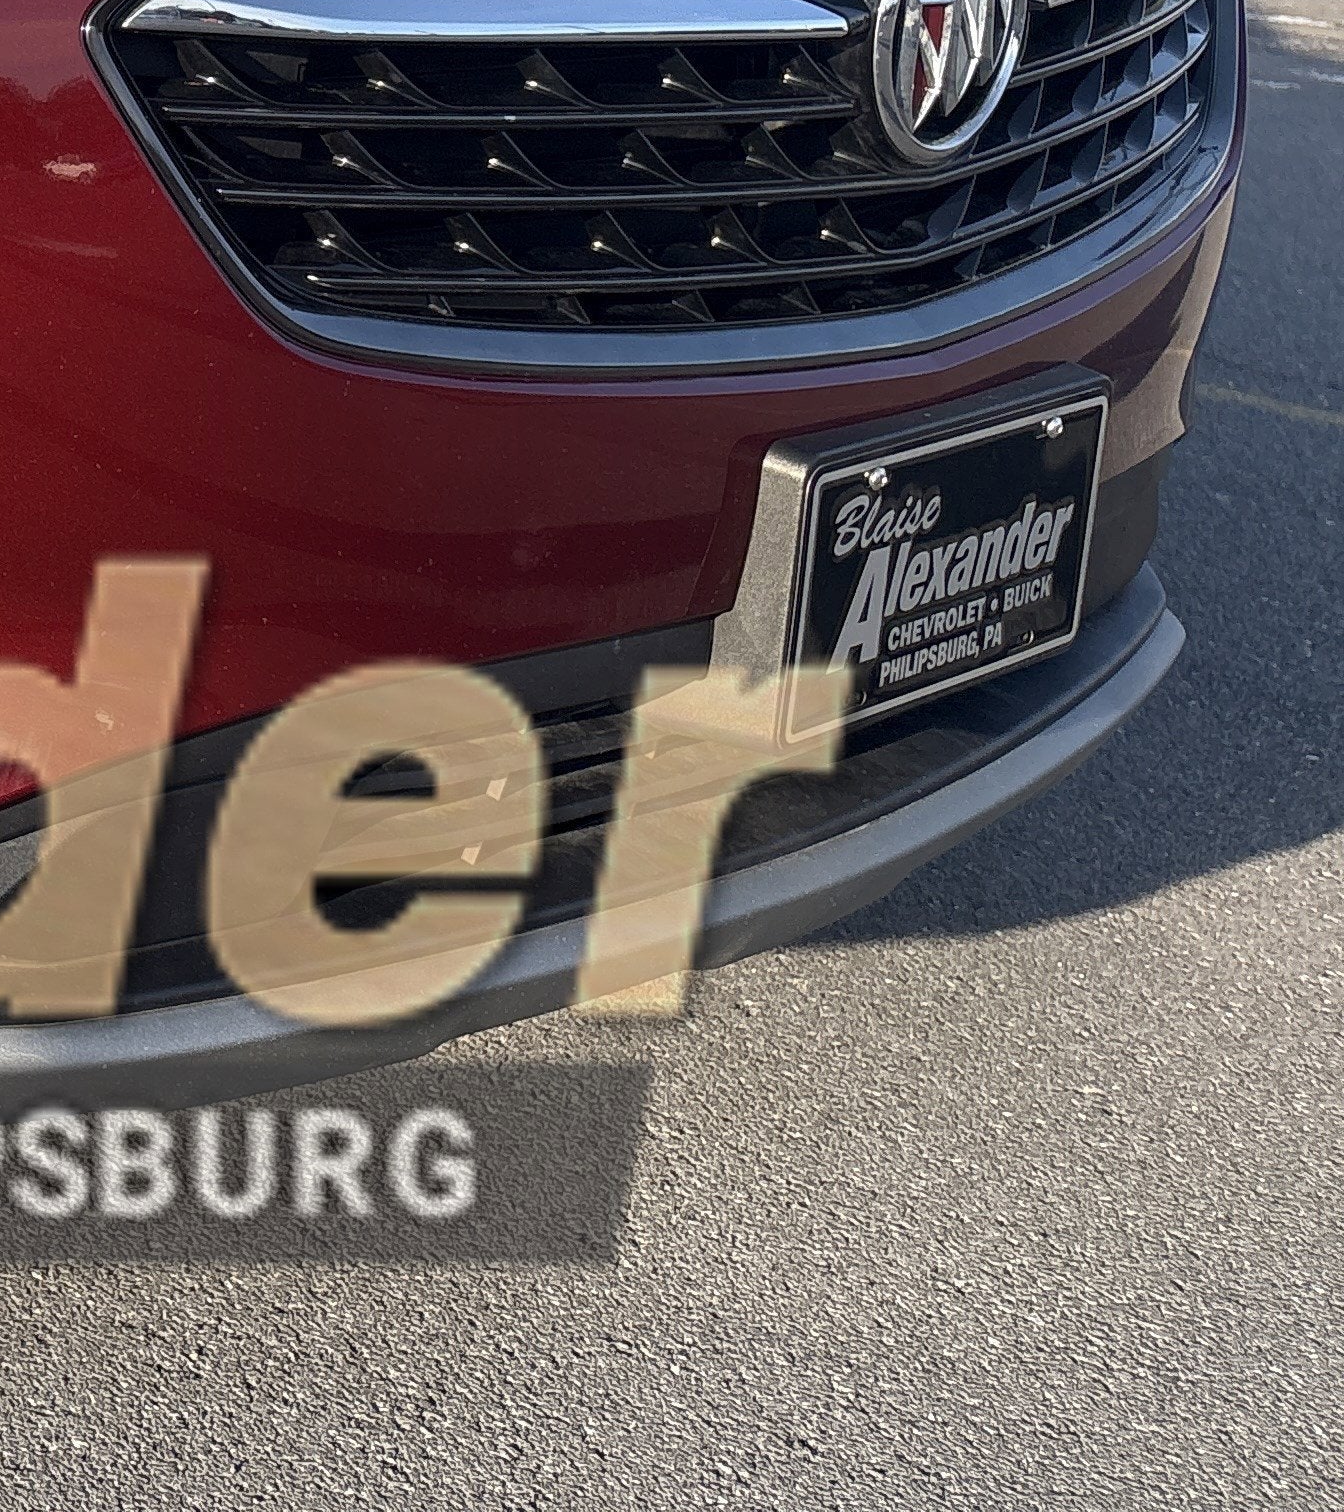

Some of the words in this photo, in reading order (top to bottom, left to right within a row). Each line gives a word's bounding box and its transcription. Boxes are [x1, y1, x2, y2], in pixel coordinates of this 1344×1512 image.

[834, 493, 941, 557] Blaise
[826, 500, 1075, 676] Alexander
[888, 596, 987, 652] CHEVROLET
[1002, 573, 1053, 614] BUICK
[983, 620, 1003, 651] PA
